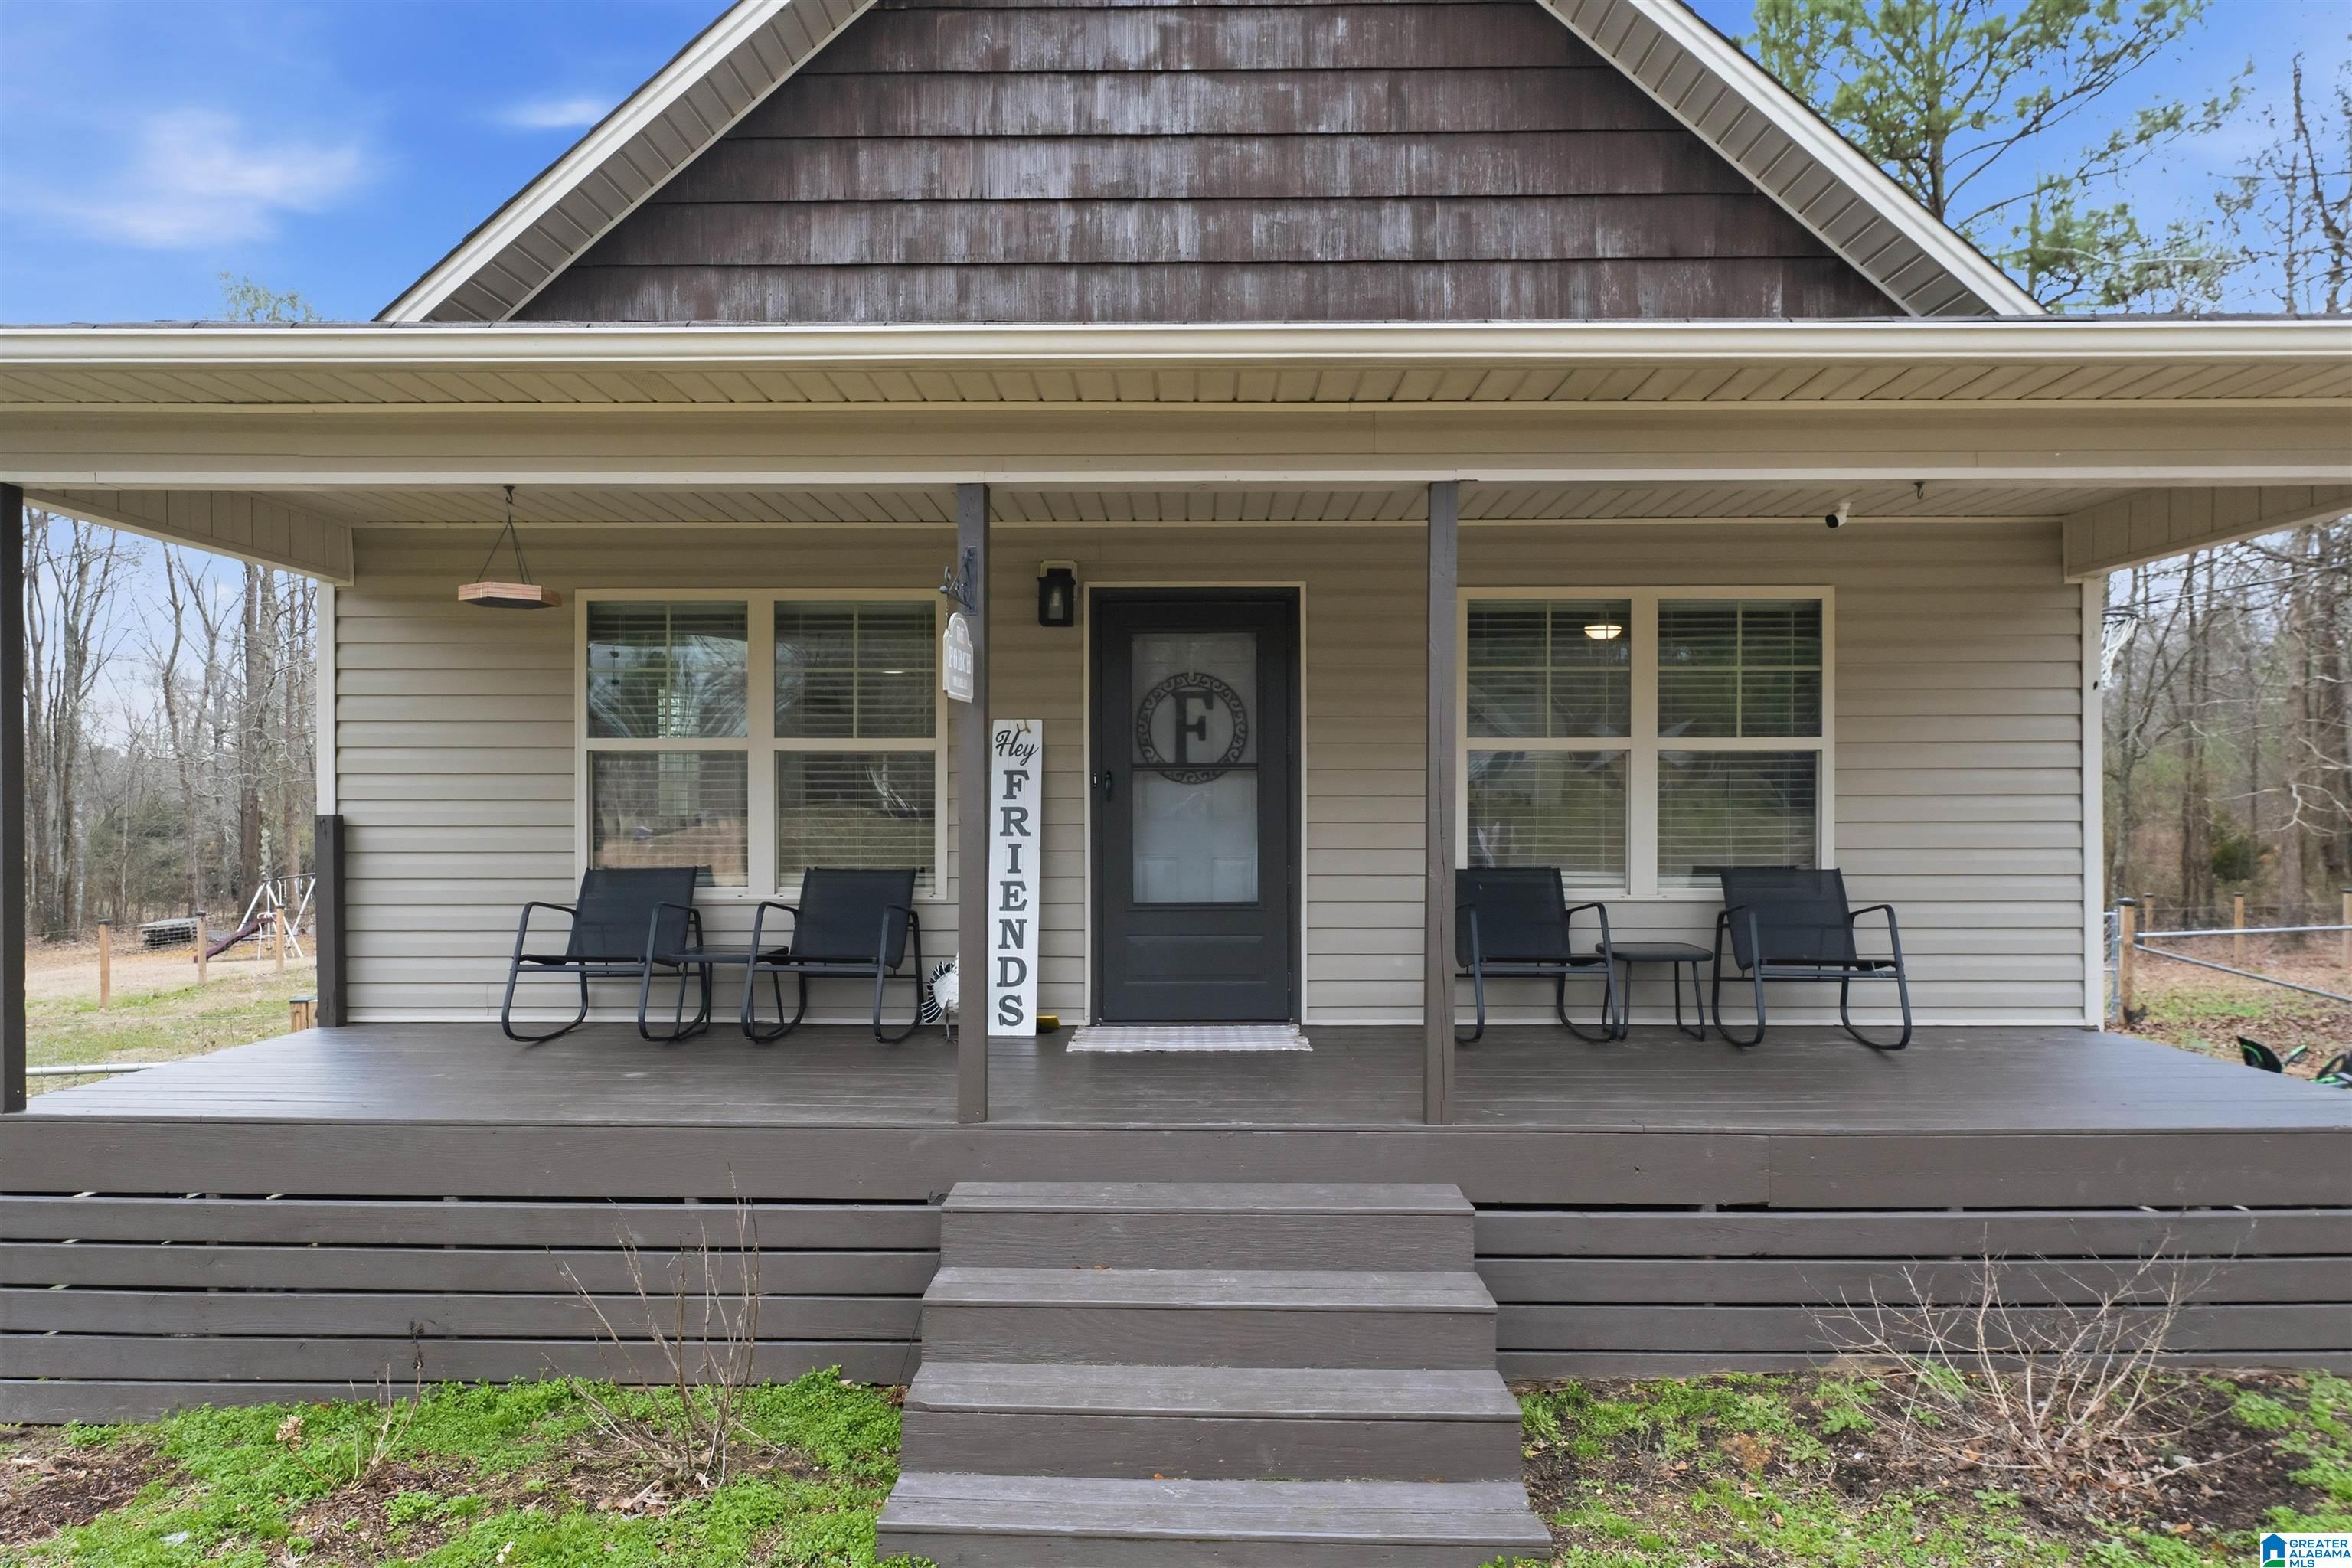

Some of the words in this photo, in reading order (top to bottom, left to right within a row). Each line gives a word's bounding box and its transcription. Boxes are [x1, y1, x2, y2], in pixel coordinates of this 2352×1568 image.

[949, 645, 972, 674] PORCH
[995, 730, 1039, 766] Hey
[1171, 691, 1214, 763] F
[996, 769, 1031, 1027] FRIENDS
